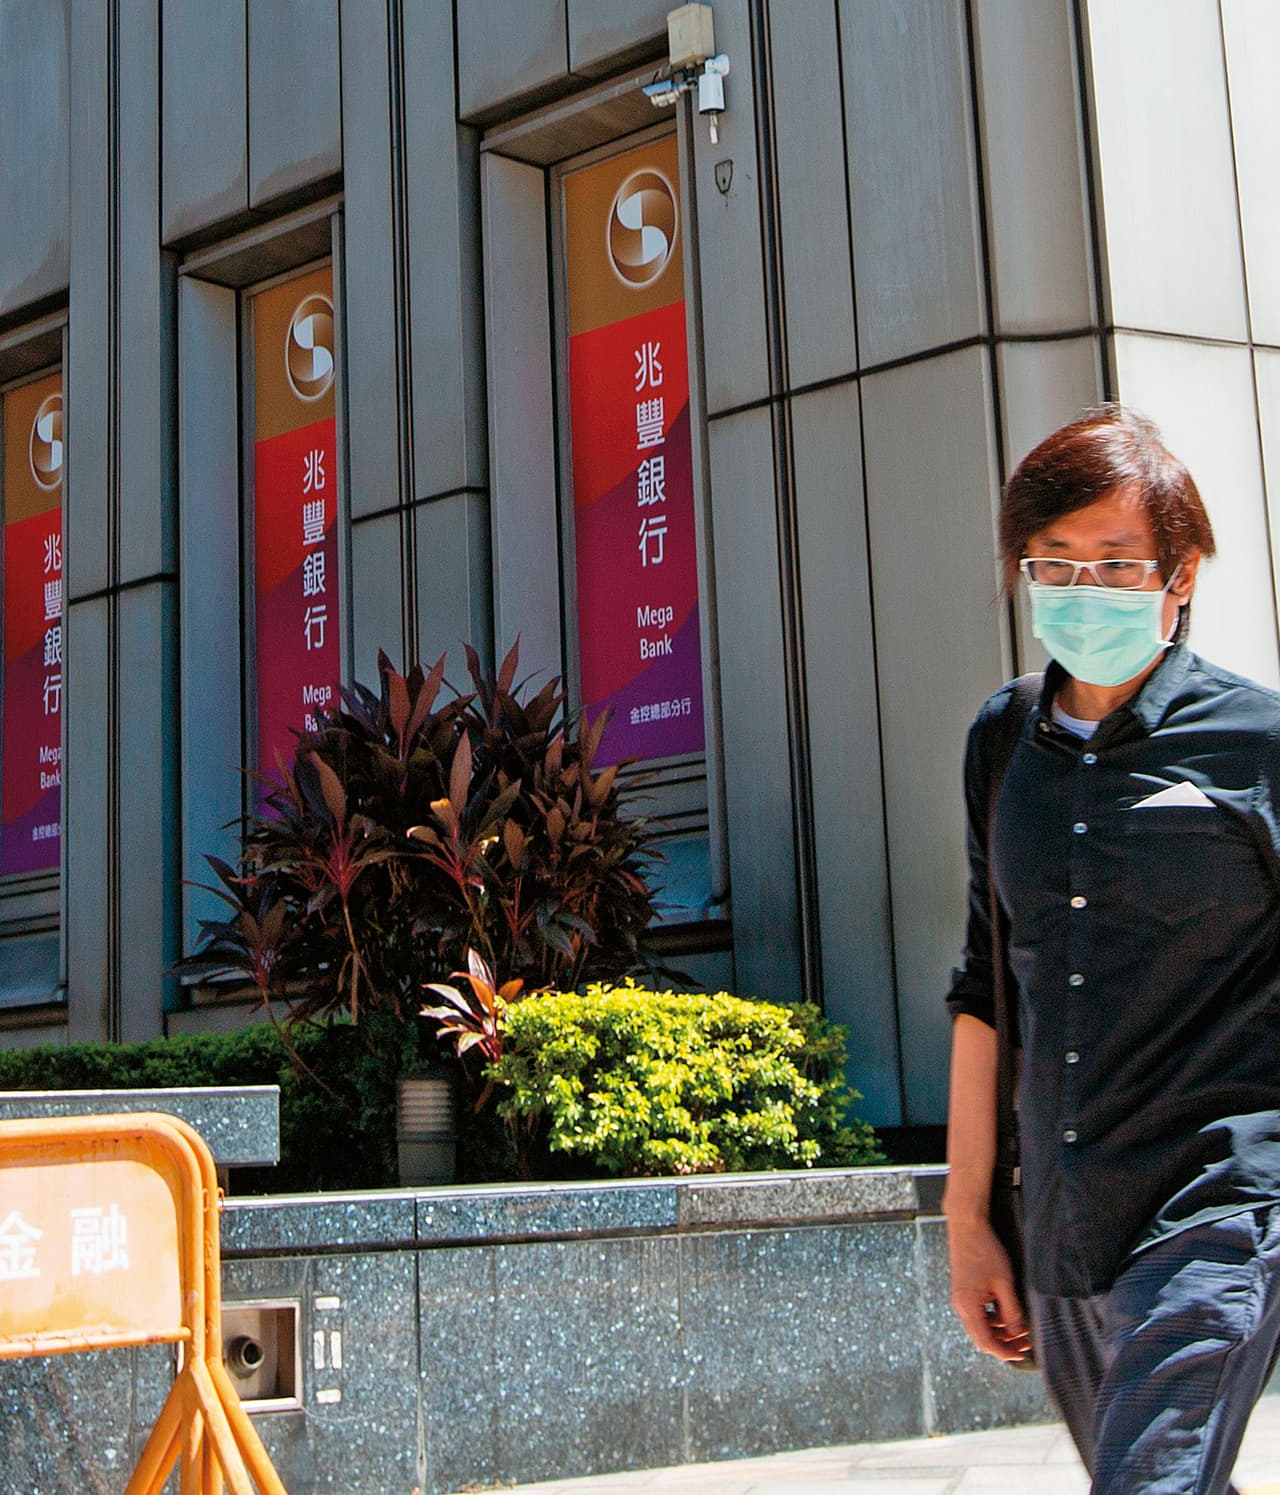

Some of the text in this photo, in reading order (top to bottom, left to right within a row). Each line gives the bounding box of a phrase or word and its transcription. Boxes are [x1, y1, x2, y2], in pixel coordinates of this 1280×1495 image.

[633, 340, 669, 569] 兆豐銀行
[302, 449, 328, 652] 兆豐銀行
[43, 532, 63, 716] 兆豐銀行
[637, 604, 674, 629] Mega
[639, 633, 673, 660] Bank
[302, 684, 332, 707] Mega
